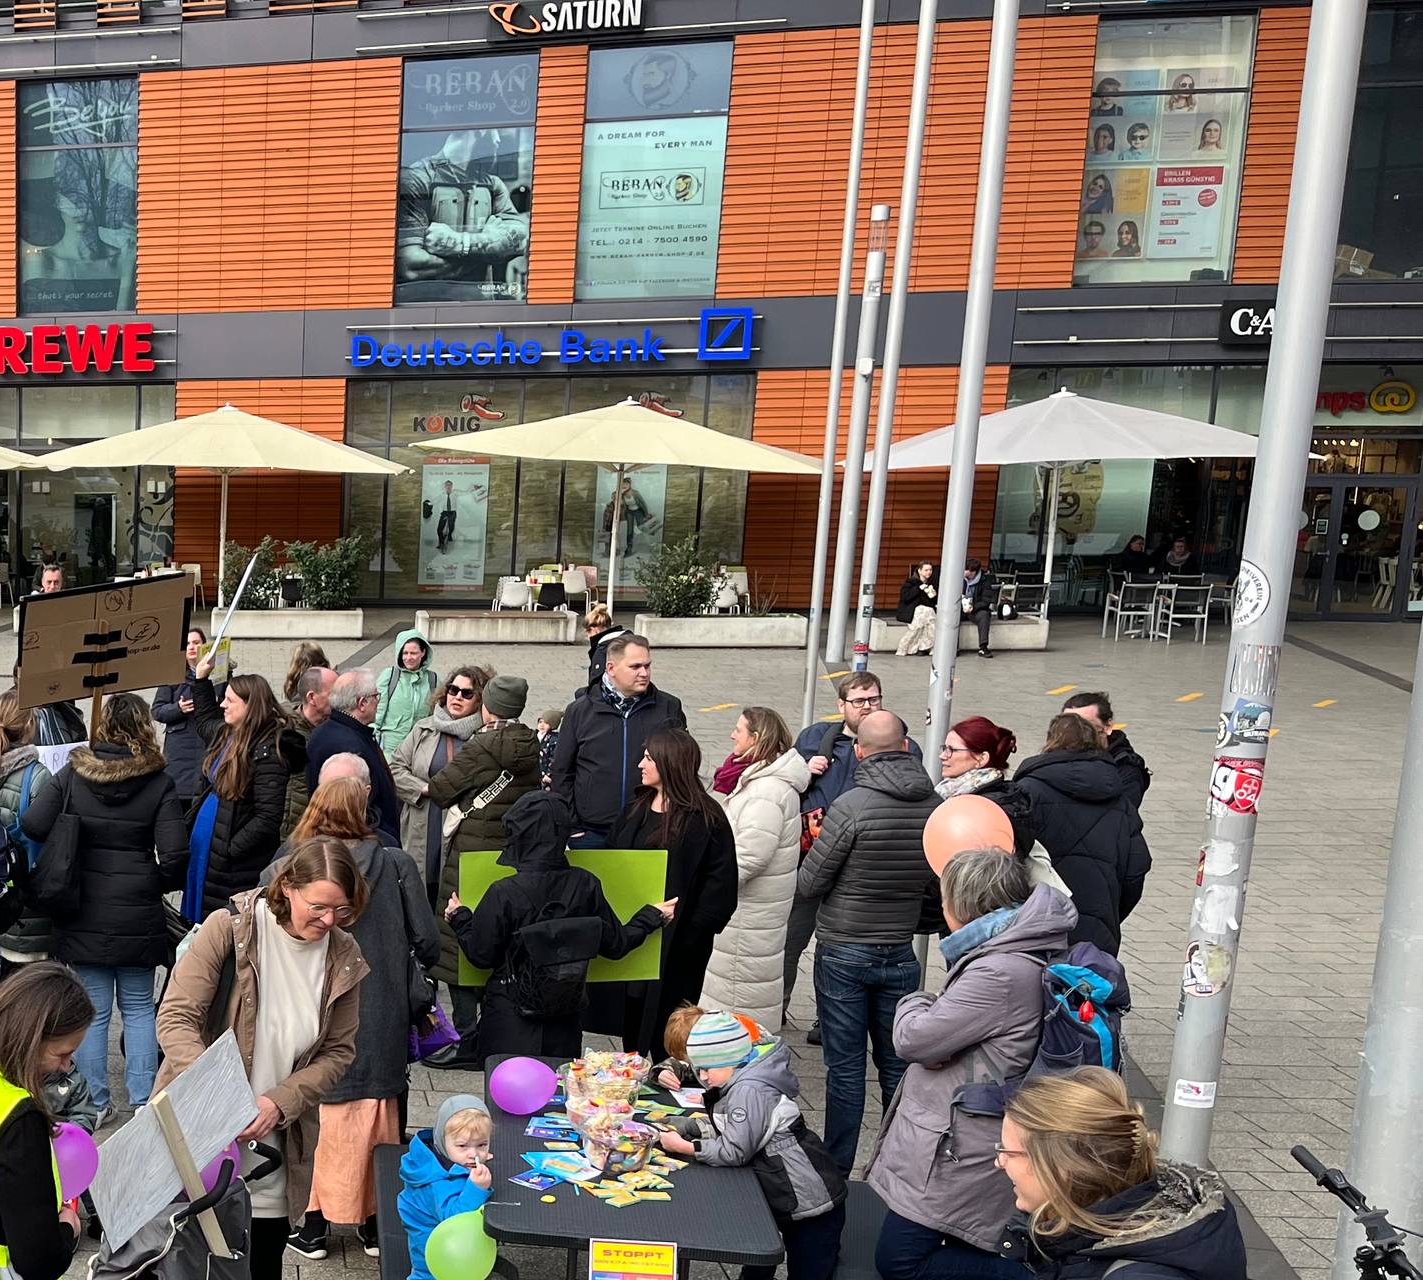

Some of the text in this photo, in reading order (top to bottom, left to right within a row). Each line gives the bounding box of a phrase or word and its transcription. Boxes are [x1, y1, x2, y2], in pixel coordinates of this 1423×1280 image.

[541, 0, 642, 32] SATURN
[598, 130, 665, 141] A DREAM FOR
[655, 139, 713, 149] EVERY MAN
[618, 237, 644, 246] 0214
[654, 236, 679, 244] 7500
[683, 234, 709, 243] 4590
[1230, 307, 1276, 336] C&A
[351, 328, 666, 368] Deutsche Bank
[603, 1249, 665, 1260] STOPPT
